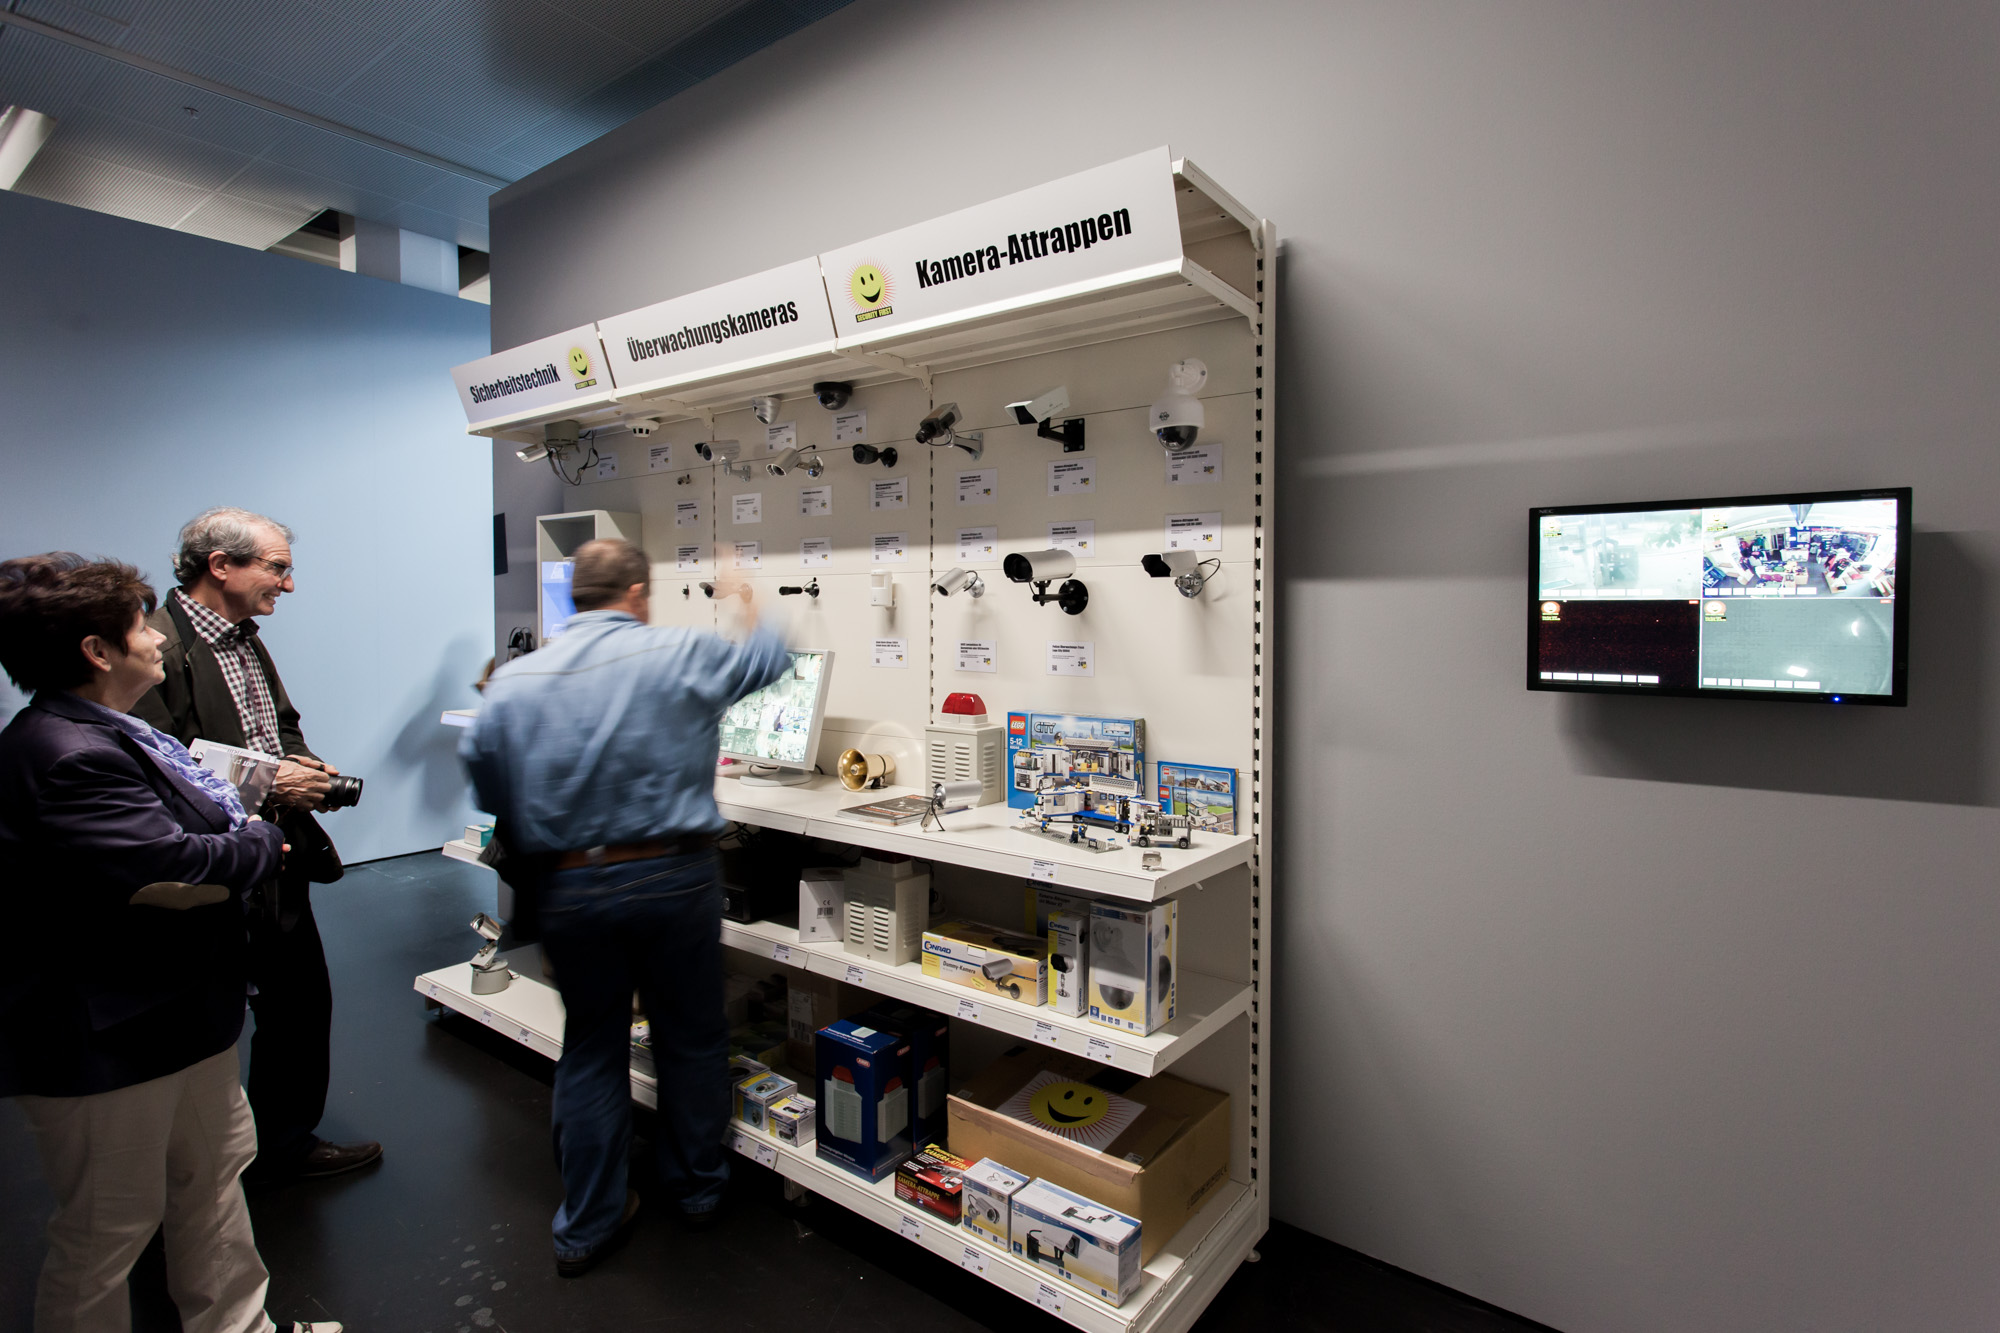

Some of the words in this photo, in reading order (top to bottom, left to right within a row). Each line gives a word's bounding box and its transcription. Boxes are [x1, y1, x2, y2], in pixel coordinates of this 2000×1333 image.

[915, 207, 1132, 289] Kamera-Attrappen
[627, 301, 798, 362] Überwachungskameras
[469, 363, 561, 404] Sicherheitstechnik
[1011, 720, 1025, 730] LEGO
[1010, 737, 1023, 746] 5-12
[924, 940, 952, 954] CONRAD
